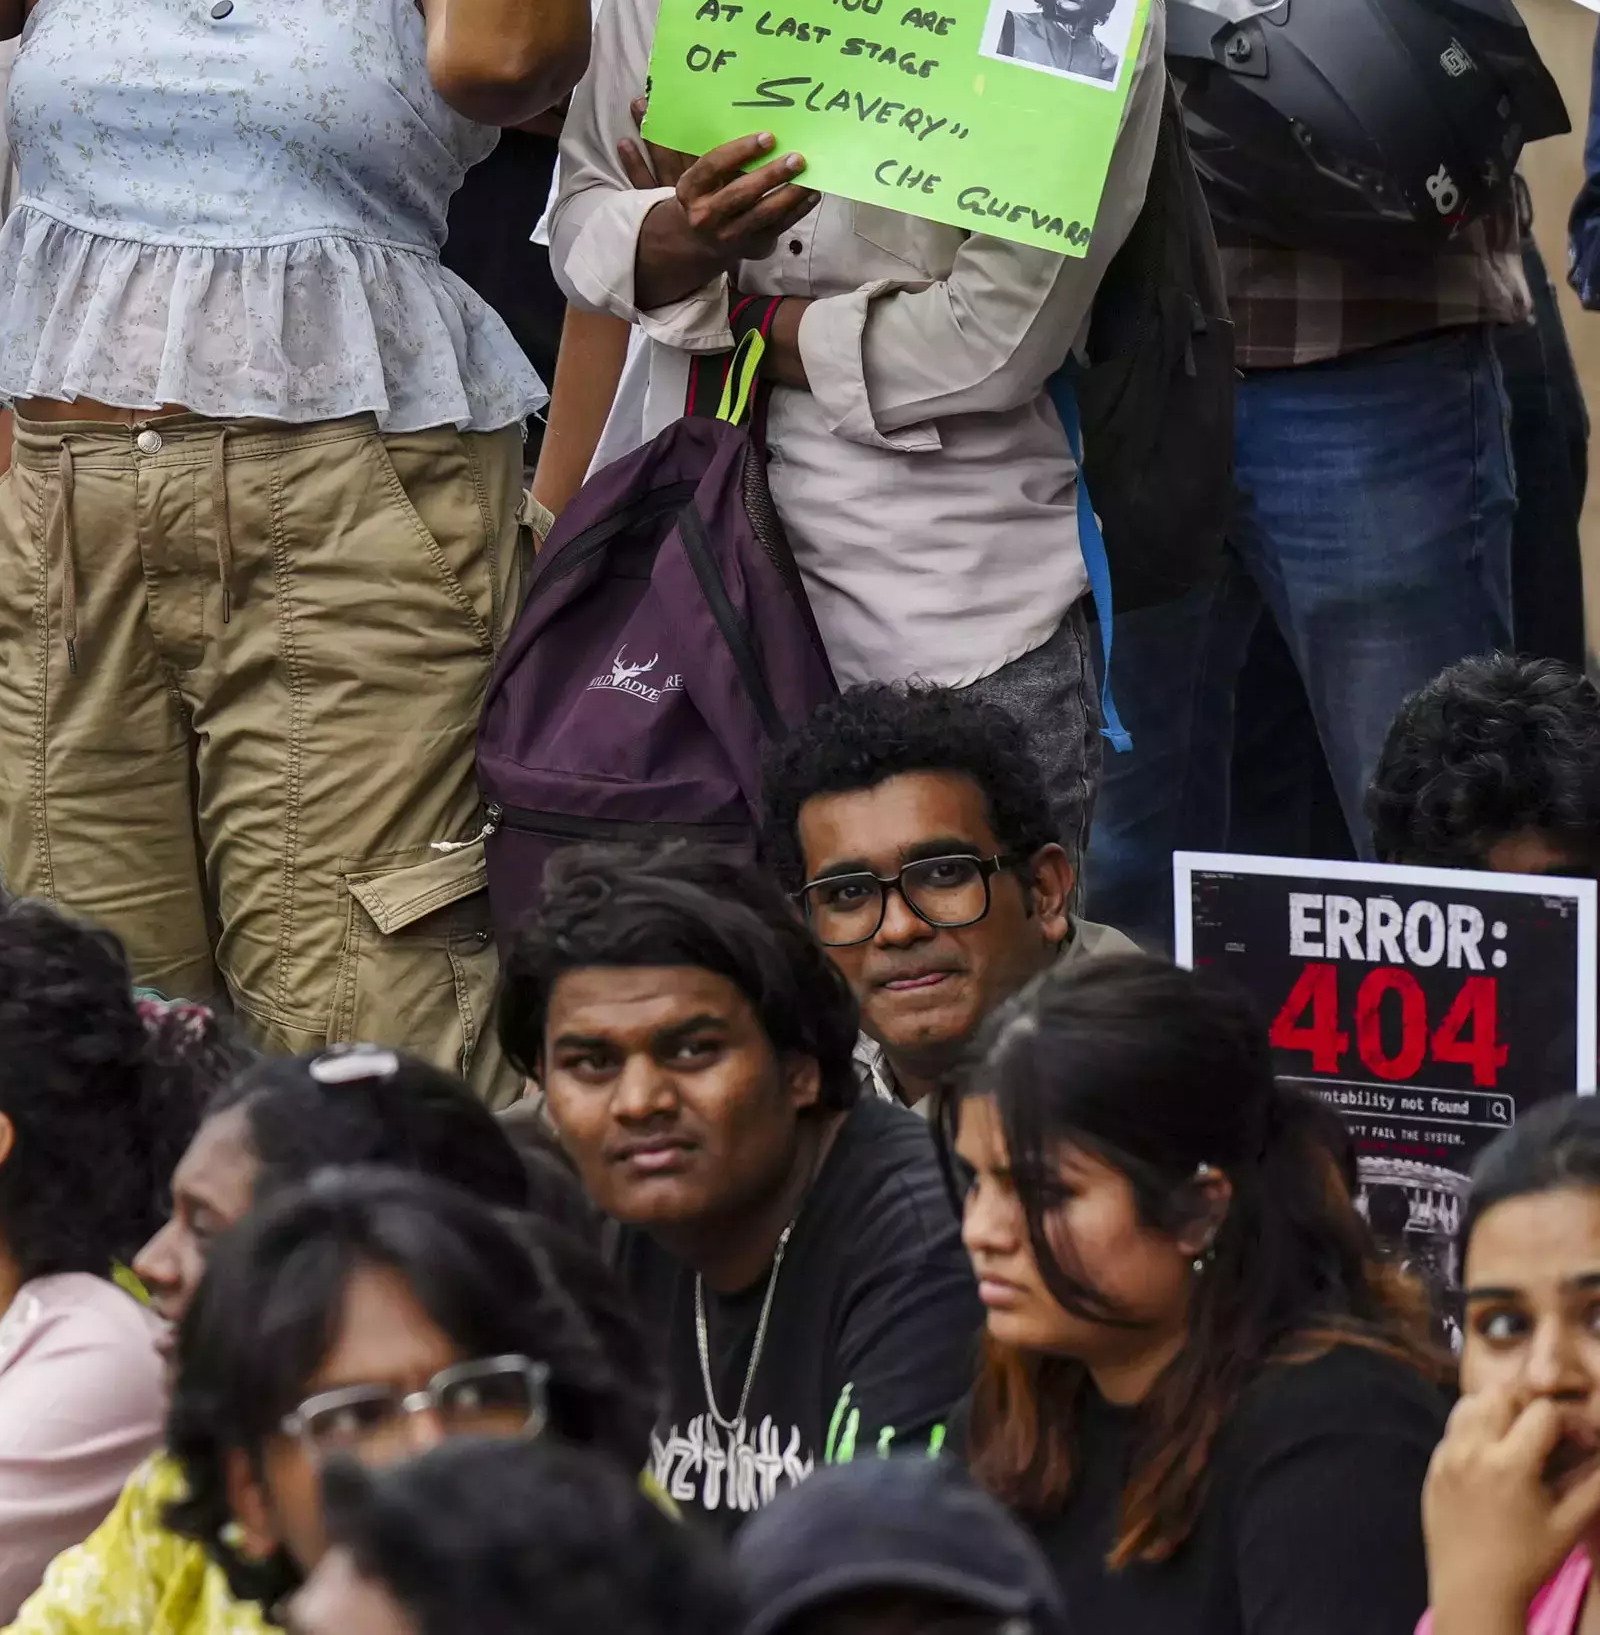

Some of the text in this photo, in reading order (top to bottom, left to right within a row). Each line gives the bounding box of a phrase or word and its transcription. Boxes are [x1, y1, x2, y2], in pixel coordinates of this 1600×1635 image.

[754, 9, 831, 46] LAST
[840, 36, 940, 80] STAGE
[899, 5, 957, 38] ARE
[685, 45, 739, 75] OF
[873, 159, 1093, 249] CHE GUEVARA
[1288, 891, 1508, 971] ERROR:
[1269, 964, 1510, 1088] 404
[1400, 1098, 1425, 1112] not
[1430, 1097, 1470, 1116] found
